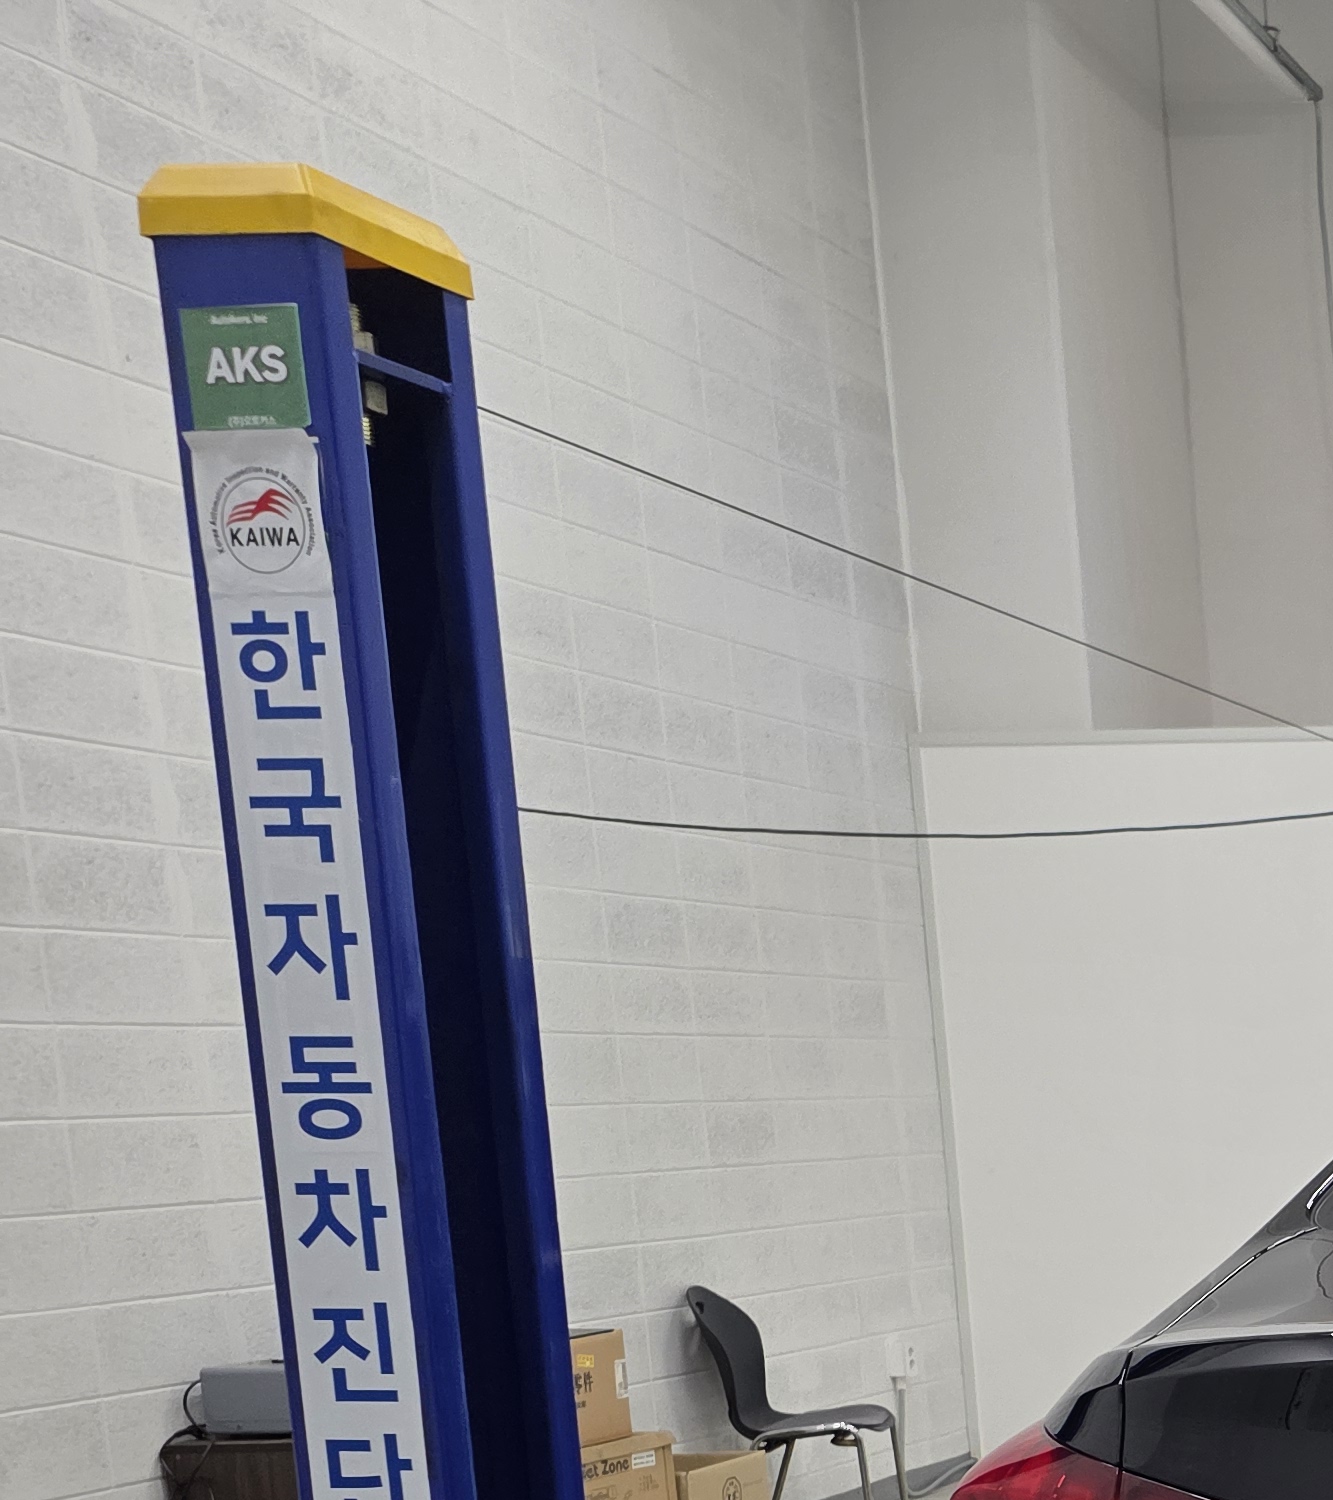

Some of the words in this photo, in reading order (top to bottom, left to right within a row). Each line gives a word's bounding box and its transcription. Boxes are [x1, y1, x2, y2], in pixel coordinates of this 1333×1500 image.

[205, 345, 288, 384] AKS
[229, 526, 300, 547] KAIWA
[601, 1458, 630, 1476] Zone
